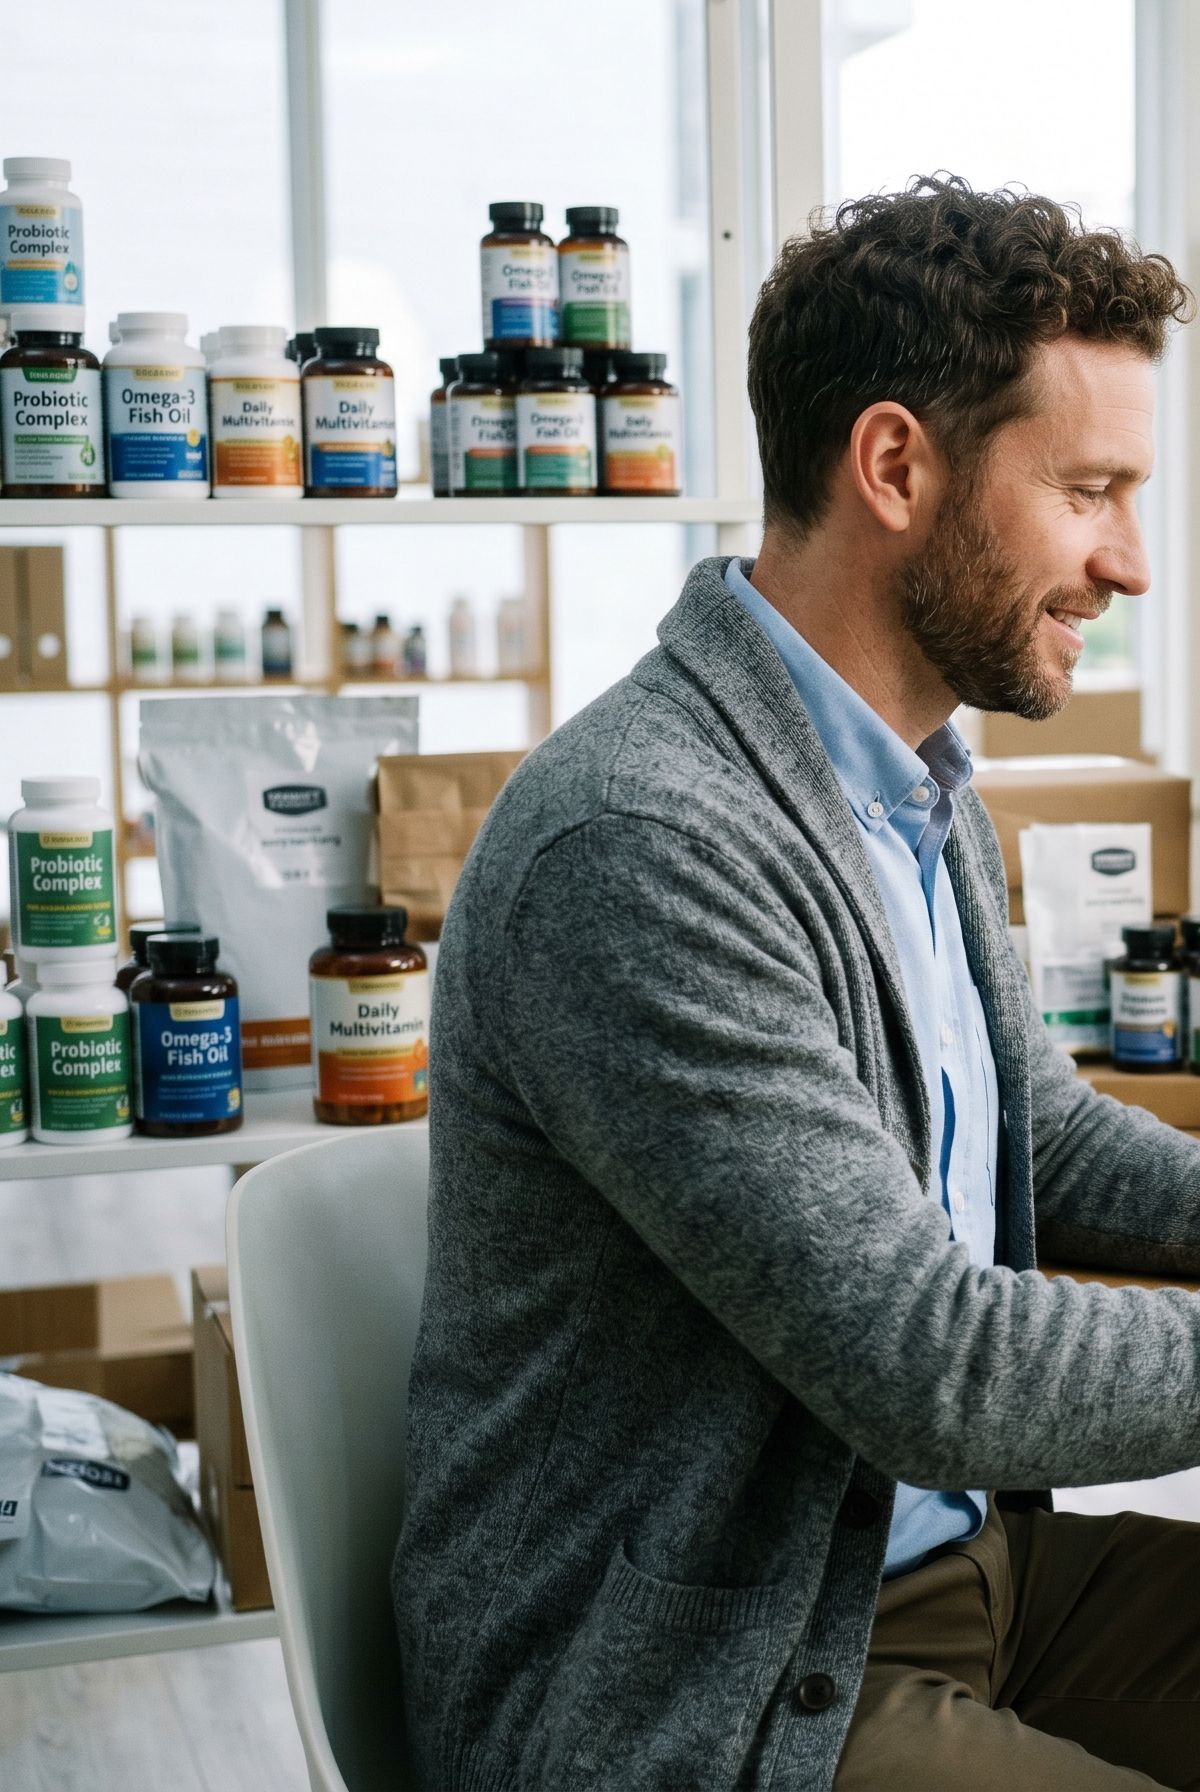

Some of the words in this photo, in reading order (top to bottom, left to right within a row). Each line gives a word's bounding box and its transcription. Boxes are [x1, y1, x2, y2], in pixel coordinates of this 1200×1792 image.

[8, 224, 70, 239] Probiotic
[10, 240, 70, 257] Complex
[14, 390, 89, 408] Probiotic
[122, 388, 196, 409] Omega-3
[243, 401, 274, 415] Daily
[339, 400, 375, 415] Daily
[15, 410, 88, 430] Complex
[129, 408, 163, 423] Fish
[169, 408, 191, 423] Oil
[30, 853, 103, 874] Probiotic
[33, 873, 103, 896] Complex
[358, 1002, 400, 1020] Daily
[51, 1038, 122, 1058] Probiotic
[167, 1048, 204, 1066] Fish
[207, 1044, 229, 1064] Oil
[52, 1057, 121, 1079] Complex
